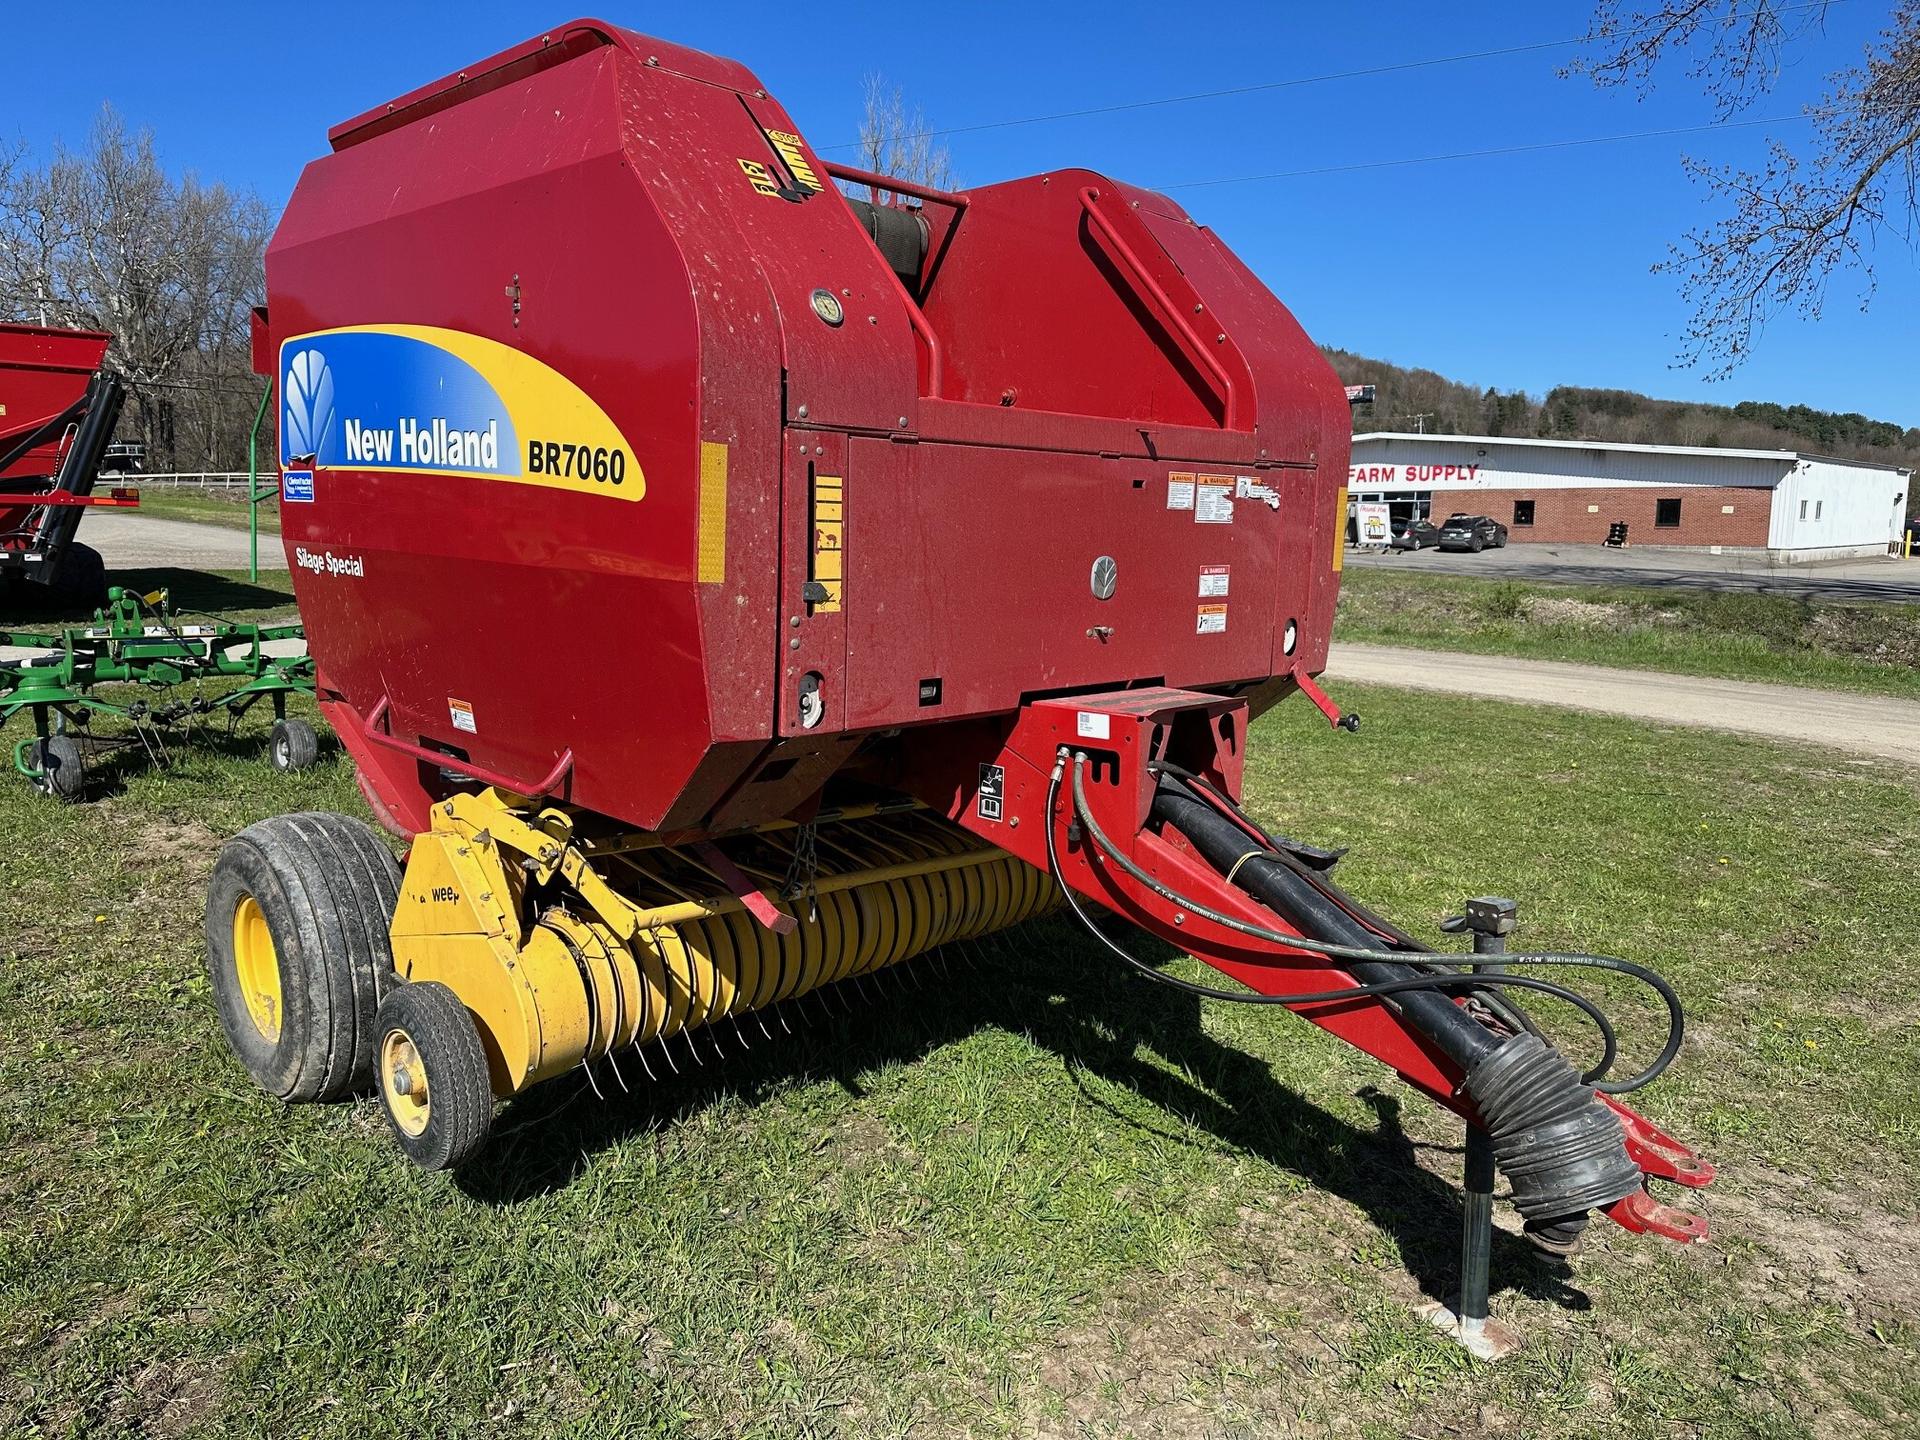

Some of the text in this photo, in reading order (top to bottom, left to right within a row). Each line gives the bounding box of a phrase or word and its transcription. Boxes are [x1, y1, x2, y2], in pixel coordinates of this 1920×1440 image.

[345, 417, 498, 468] New Holland
[529, 440, 625, 485] BR7060
[1404, 464, 1479, 481] SUPPLY
[296, 547, 364, 577] Silage Special
[1177, 897, 1219, 921] WEATHERHEAD
[1547, 957, 1593, 965] WEATHERHEAD
